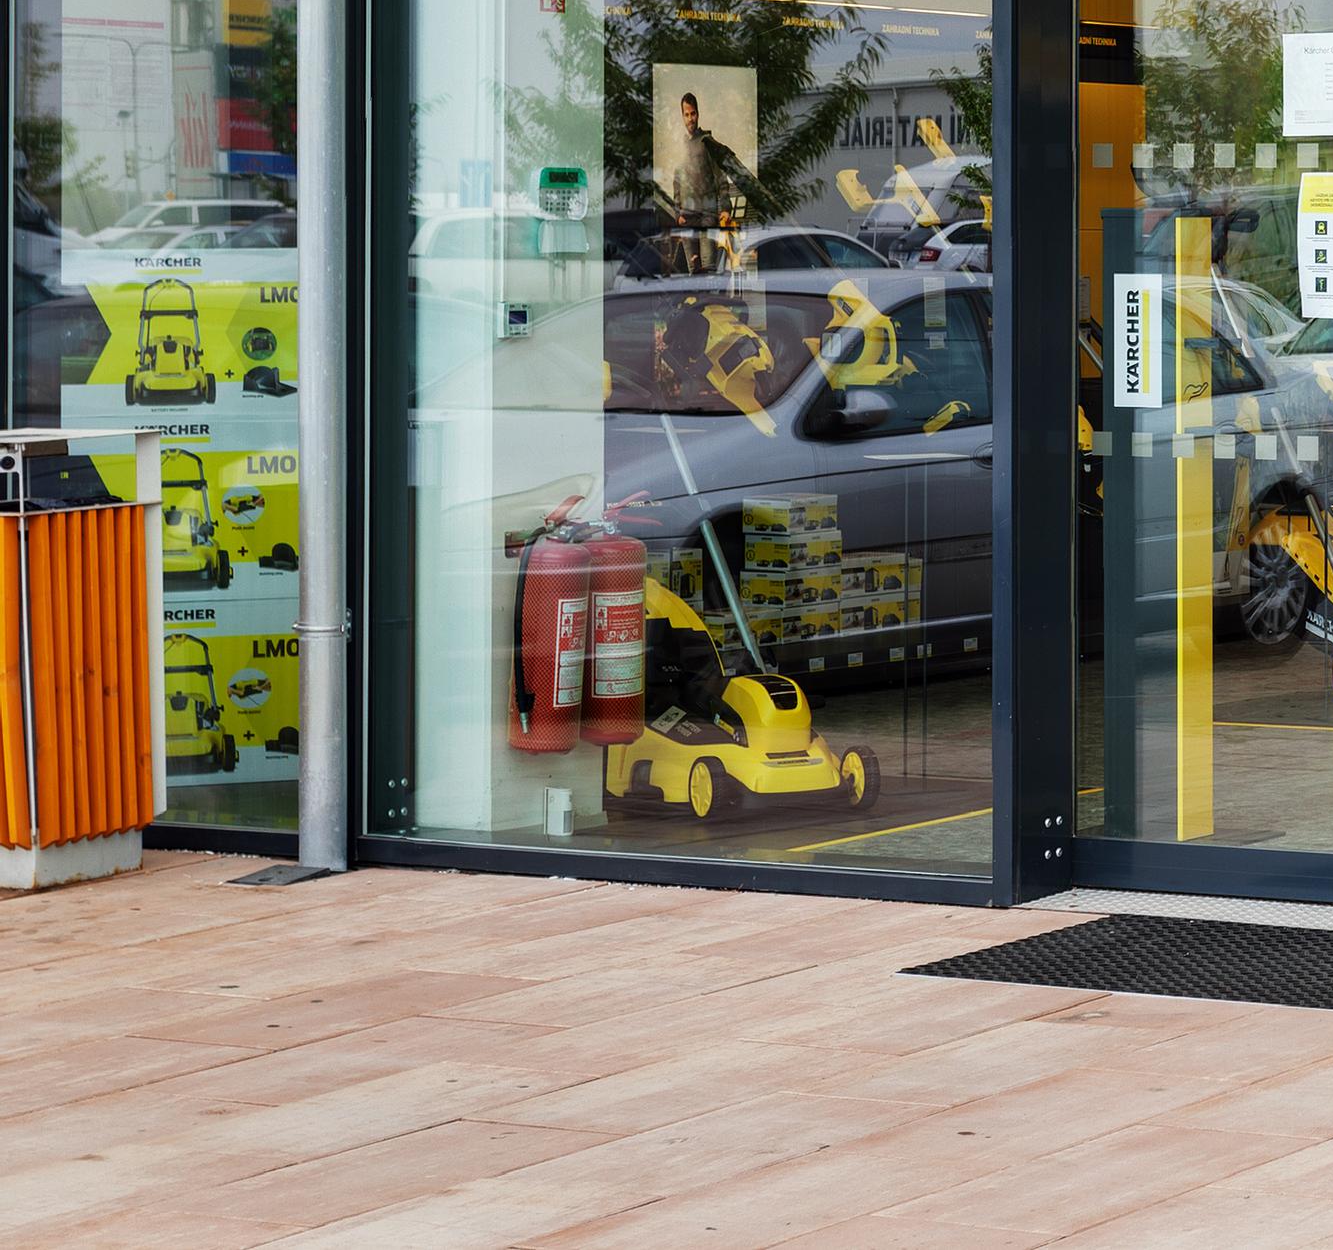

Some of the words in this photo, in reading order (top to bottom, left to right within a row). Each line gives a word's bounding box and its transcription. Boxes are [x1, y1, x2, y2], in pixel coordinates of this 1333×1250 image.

[135, 258, 202, 268] KÄRCHER
[1127, 289, 1139, 393] KÄRCHER
[135, 424, 209, 435] RCHER
[247, 455, 296, 474] LMO
[164, 609, 215, 620] RCHER
[253, 639, 299, 658] LMO
